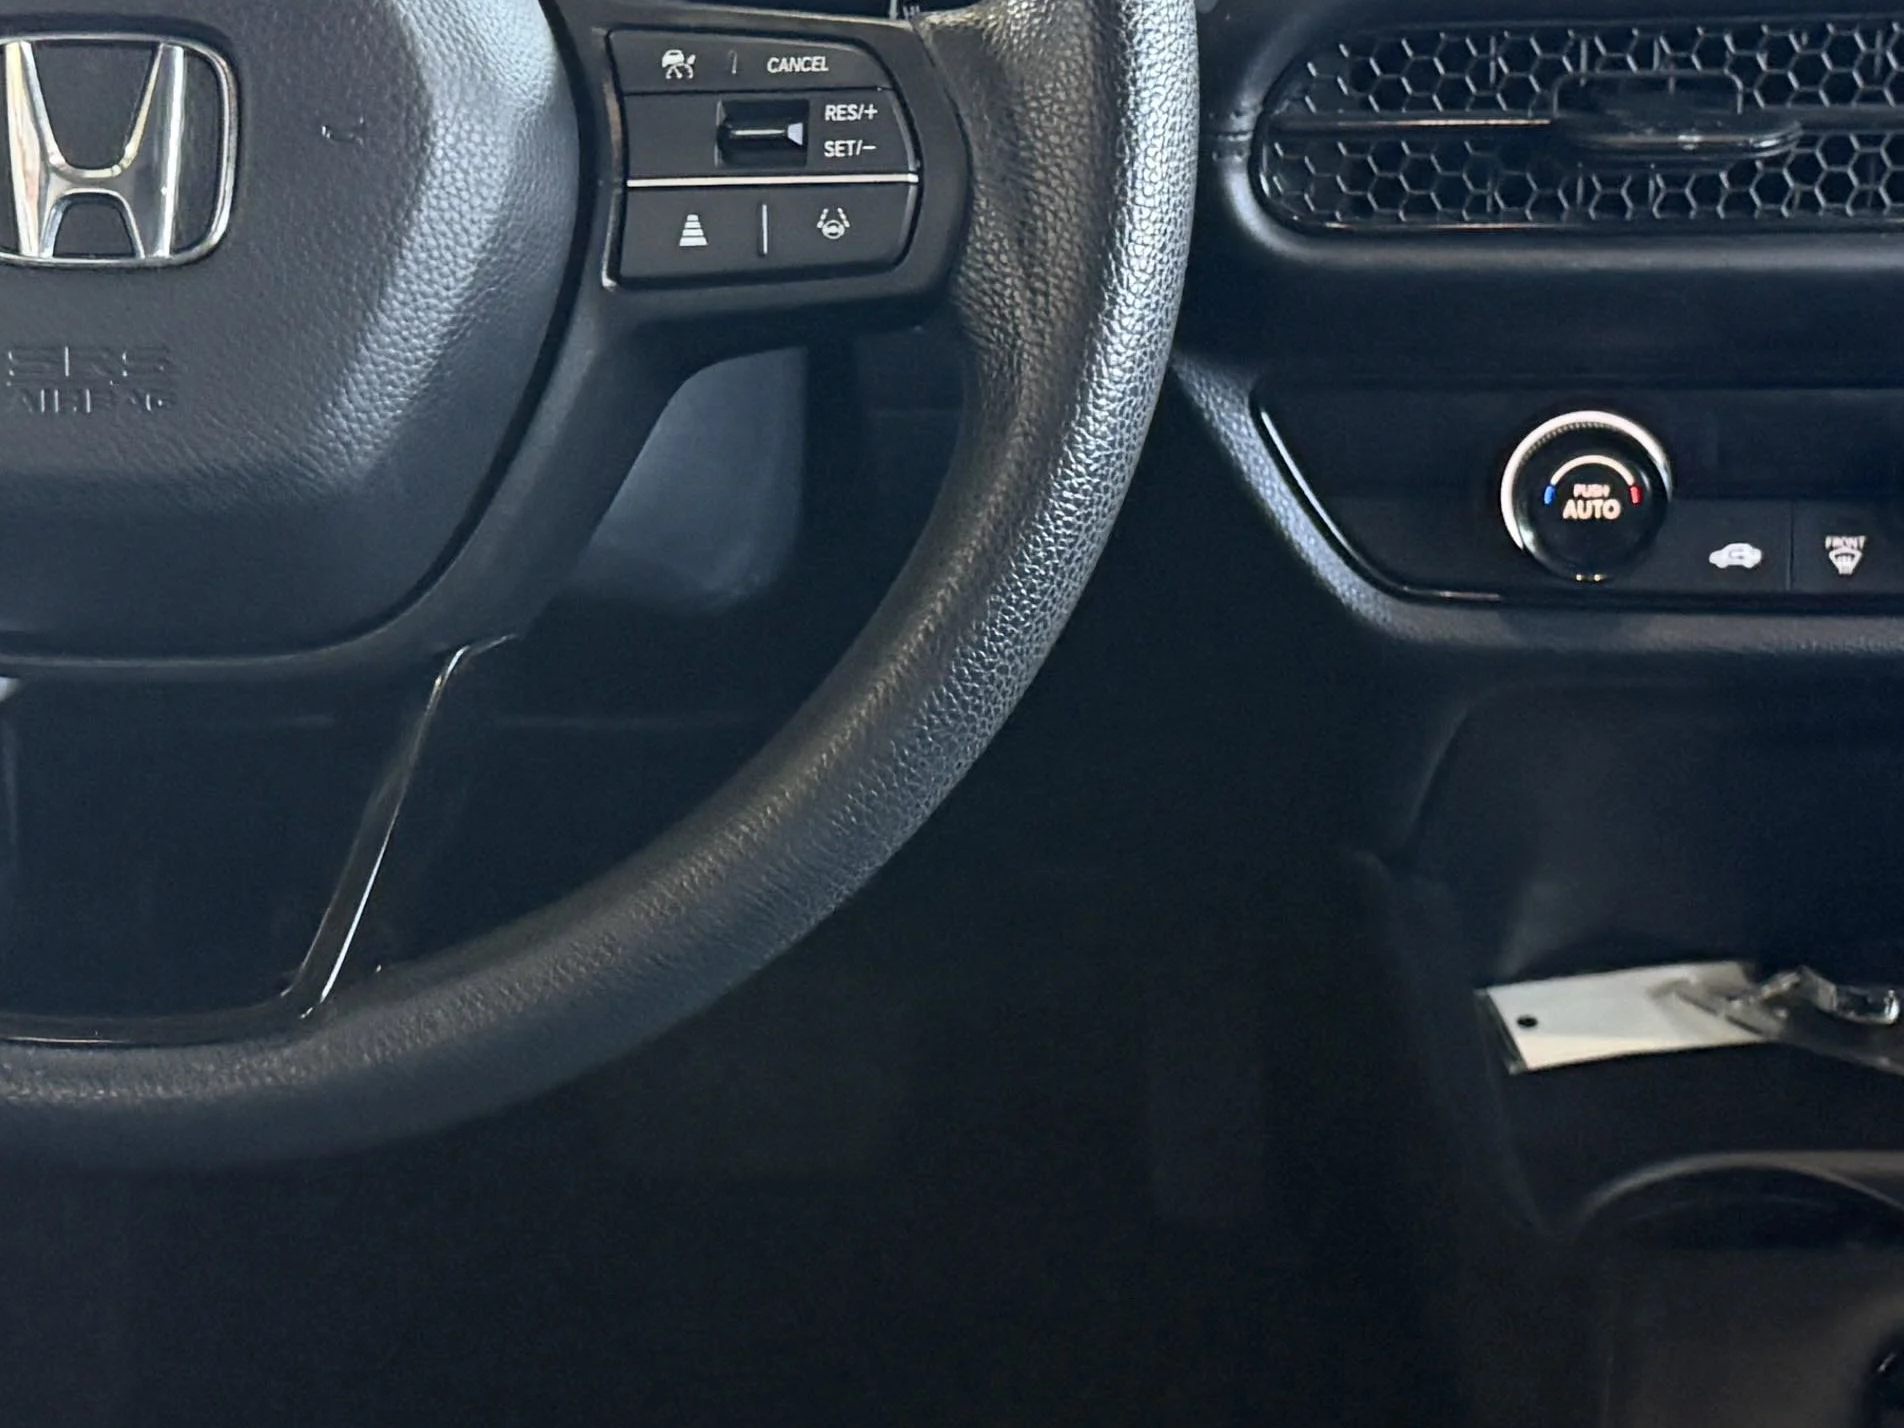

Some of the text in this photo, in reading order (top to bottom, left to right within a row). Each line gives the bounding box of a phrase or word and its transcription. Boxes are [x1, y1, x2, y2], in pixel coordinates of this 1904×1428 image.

[766, 56, 829, 73] CANCEL
[824, 103, 878, 121] RES/+
[1562, 498, 1621, 520] AUTO
